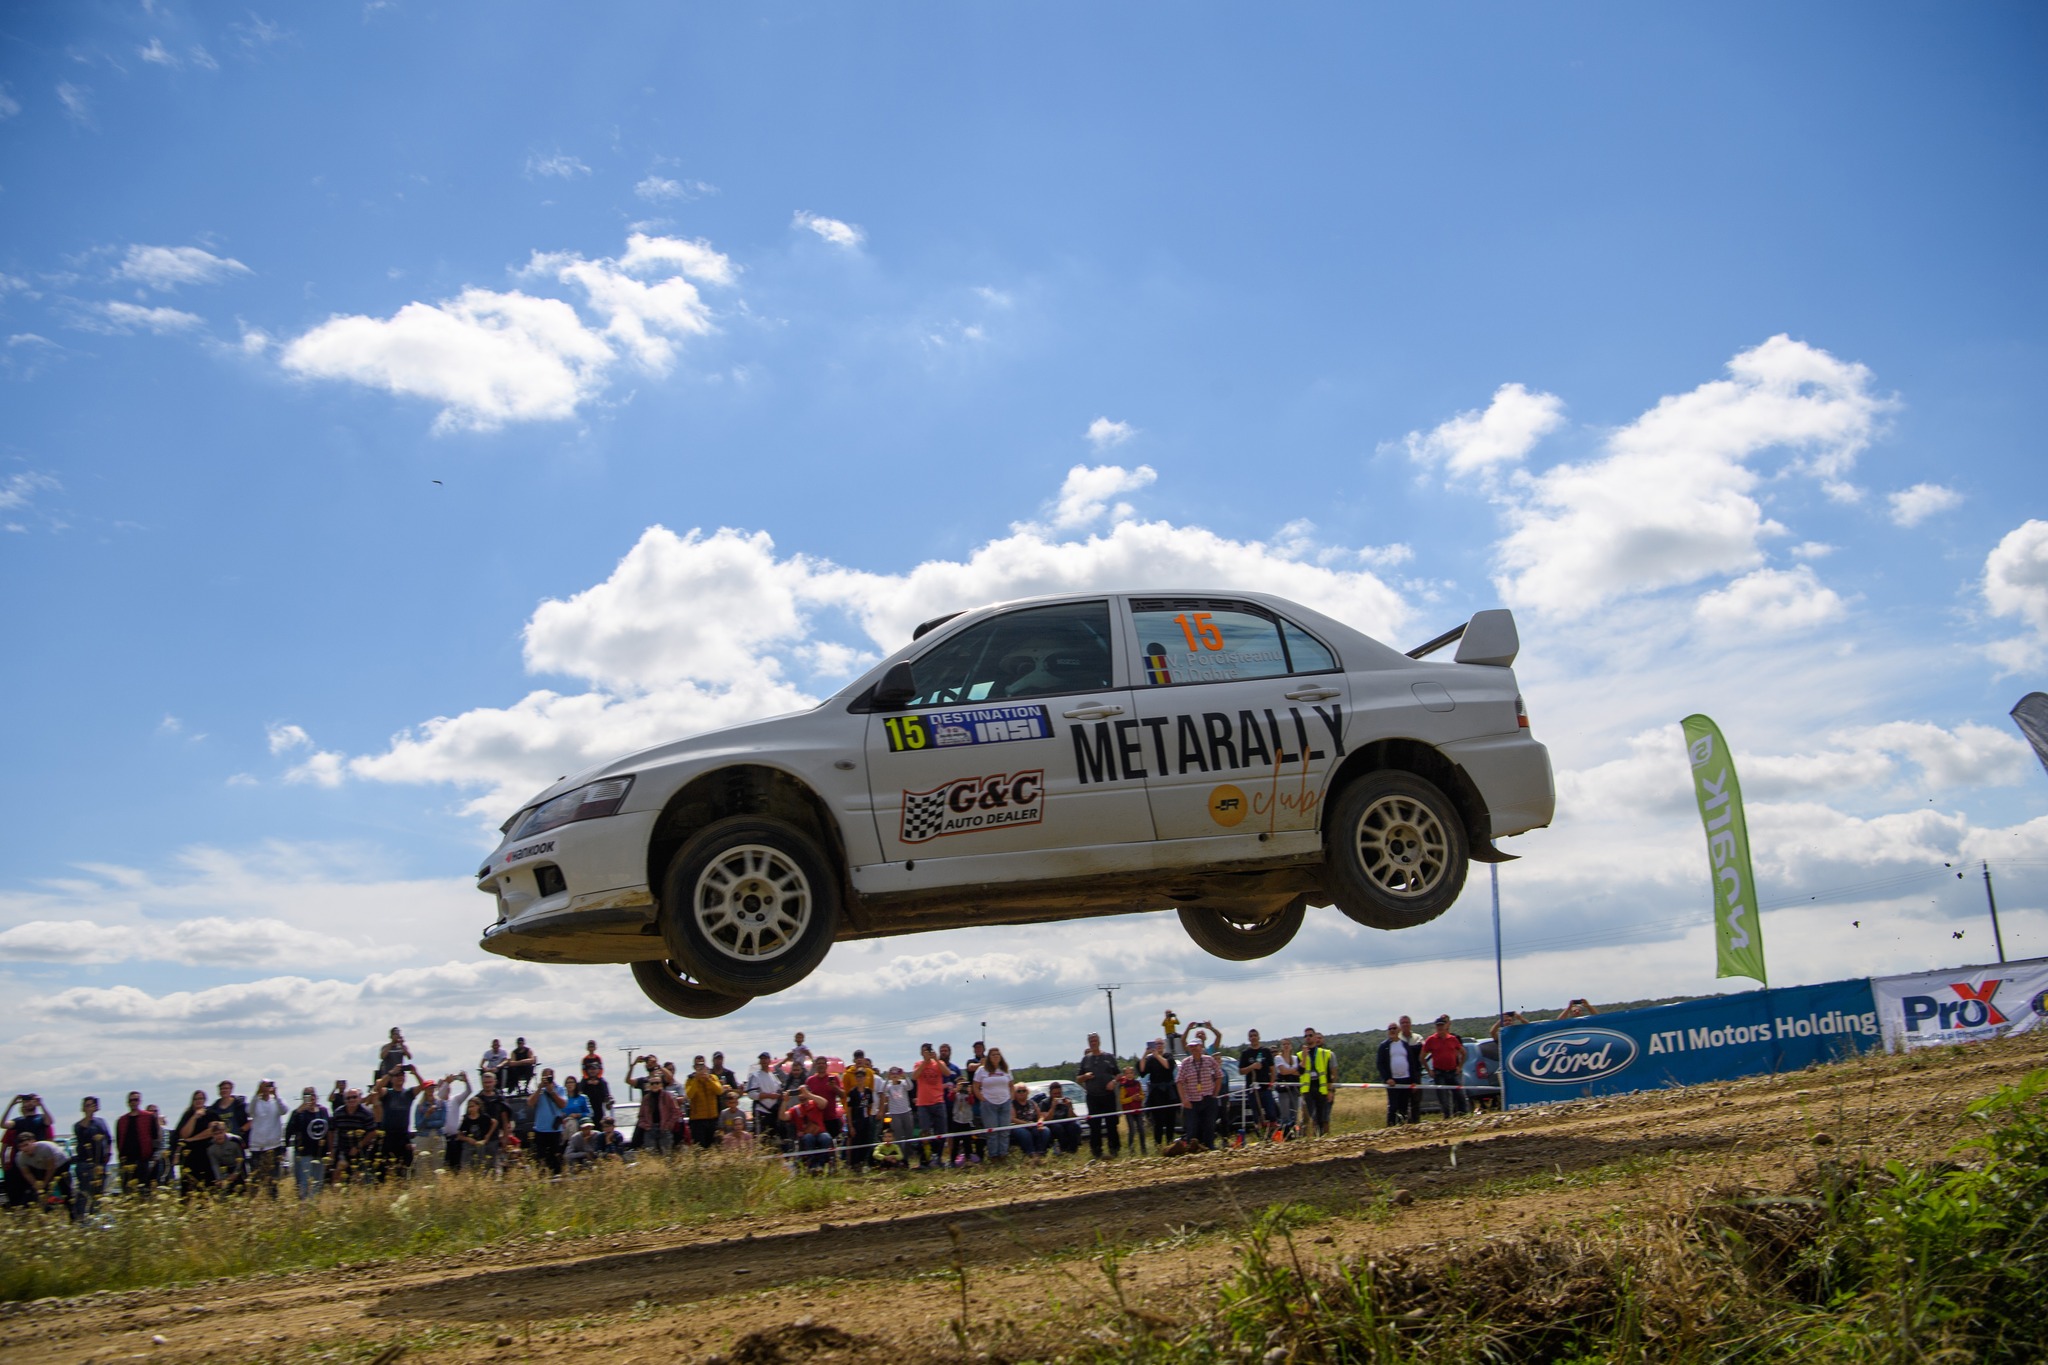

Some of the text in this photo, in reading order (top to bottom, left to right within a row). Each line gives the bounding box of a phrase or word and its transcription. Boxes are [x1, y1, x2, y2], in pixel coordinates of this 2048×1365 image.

[1173, 612, 1225, 652] 15
[885, 715, 926, 751] 15
[929, 705, 1042, 726] DESTINATION
[1069, 703, 1346, 785] METARALLY
[948, 774, 1039, 814] G&C
[944, 808, 1039, 831] AUTO DEALER
[1648, 1030, 1686, 1056] ATI
[1687, 1022, 1773, 1051] Motors
[1775, 1010, 1878, 1039] Holding
[1530, 1036, 1613, 1076] Ford
